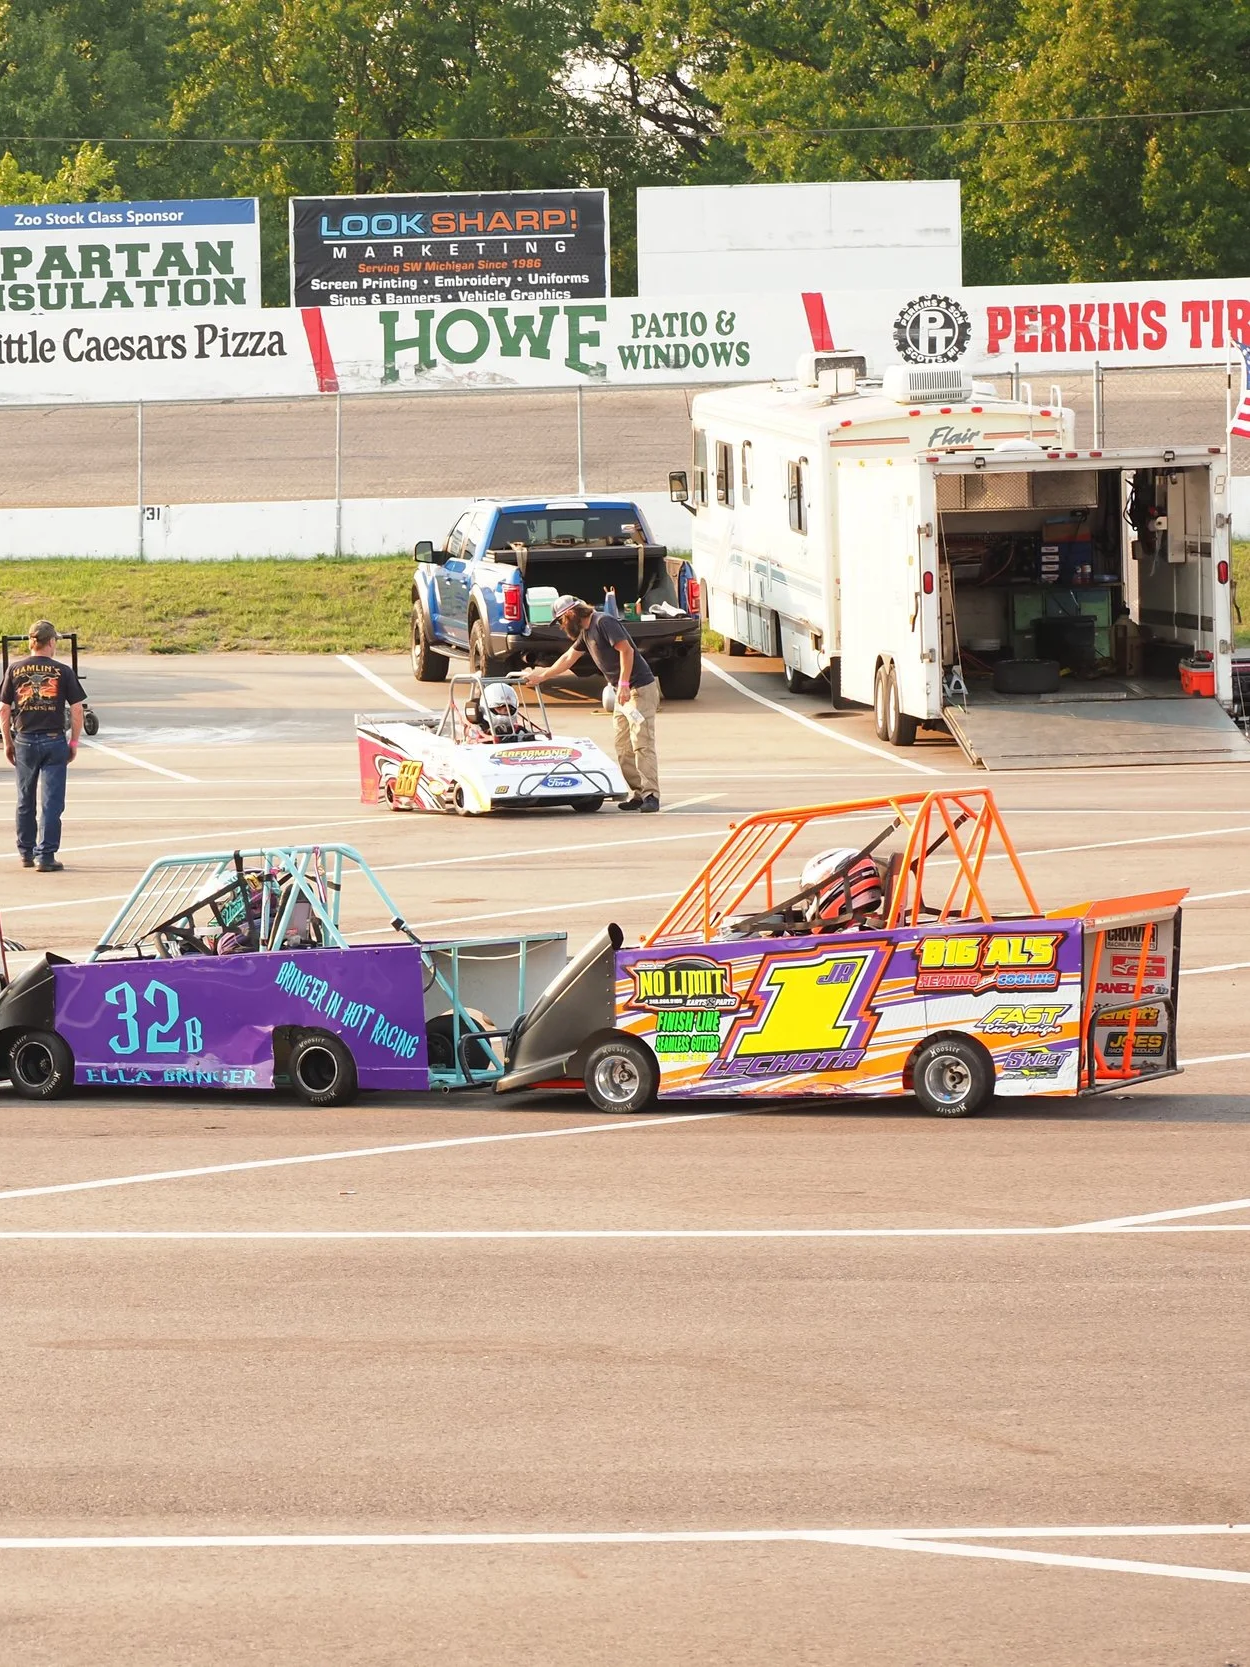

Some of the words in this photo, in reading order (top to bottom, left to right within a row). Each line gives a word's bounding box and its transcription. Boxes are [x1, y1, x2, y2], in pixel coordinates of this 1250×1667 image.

[14, 213, 41, 227] Zoo
[46, 211, 84, 225] Stock
[88, 210, 122, 223] Class
[126, 210, 184, 227] Sponsor
[321, 213, 425, 237] LOOK
[431, 209, 578, 233] SHARP!
[333, 241, 566, 259] MARKETING
[358, 263, 400, 274] Serving
[403, 262, 422, 272] SW
[425, 261, 474, 272] Michigan
[477, 260, 508, 270] Since
[511, 258, 542, 269] 1986
[310, 279, 358, 291] Screen
[362, 278, 417, 291] Printing
[434, 275, 511, 289] Embroidery
[528, 273, 590, 285] Uniforms
[329, 294, 367, 306] Signs
[370, 293, 381, 304] &
[385, 292, 442, 304] Banners
[458, 290, 507, 302] Vehicle
[511, 289, 571, 302] Graphics
[900, 299, 938, 327] PERKINS
[948, 305, 965, 325] SON
[631, 312, 707, 339] PATIO
[716, 310, 736, 335] &
[987, 300, 1167, 354] PERKINS
[63, 327, 187, 363] Caesars
[194, 323, 287, 359] Pizza
[379, 305, 607, 385] HOWE
[947, 345, 959, 358] MI
[617, 341, 750, 370] WINDOWS
[928, 425, 981, 448] Flair
[13, 664, 62, 677] HAMLIN'S
[547, 778, 573, 787] Ford
[816, 961, 858, 985] JR
[919, 975, 979, 988] HEATING
[997, 973, 1056, 986] COOLING
[639, 970, 665, 1000] NO
[668, 969, 726, 999] LIMIT
[735, 957, 867, 1056] 1
[982, 1006, 1064, 1024] FAST
[324, 990, 344, 1020] IN
[341, 1001, 376, 1038] HOT
[369, 1013, 420, 1059] RACING
[656, 1011, 695, 1032] FINISH
[695, 1011, 721, 1032] LINE
[983, 1023, 1020, 1037] Racing
[1020, 1023, 1062, 1037] Designs
[655, 1034, 691, 1052] SEAMLESS
[690, 1034, 721, 1052] GUTTERS
[929, 1046, 961, 1058] Hoosier
[702, 1049, 866, 1078] LECHOTA
[87, 1068, 152, 1086] ELLA
[163, 1068, 257, 1086] BRINGER
